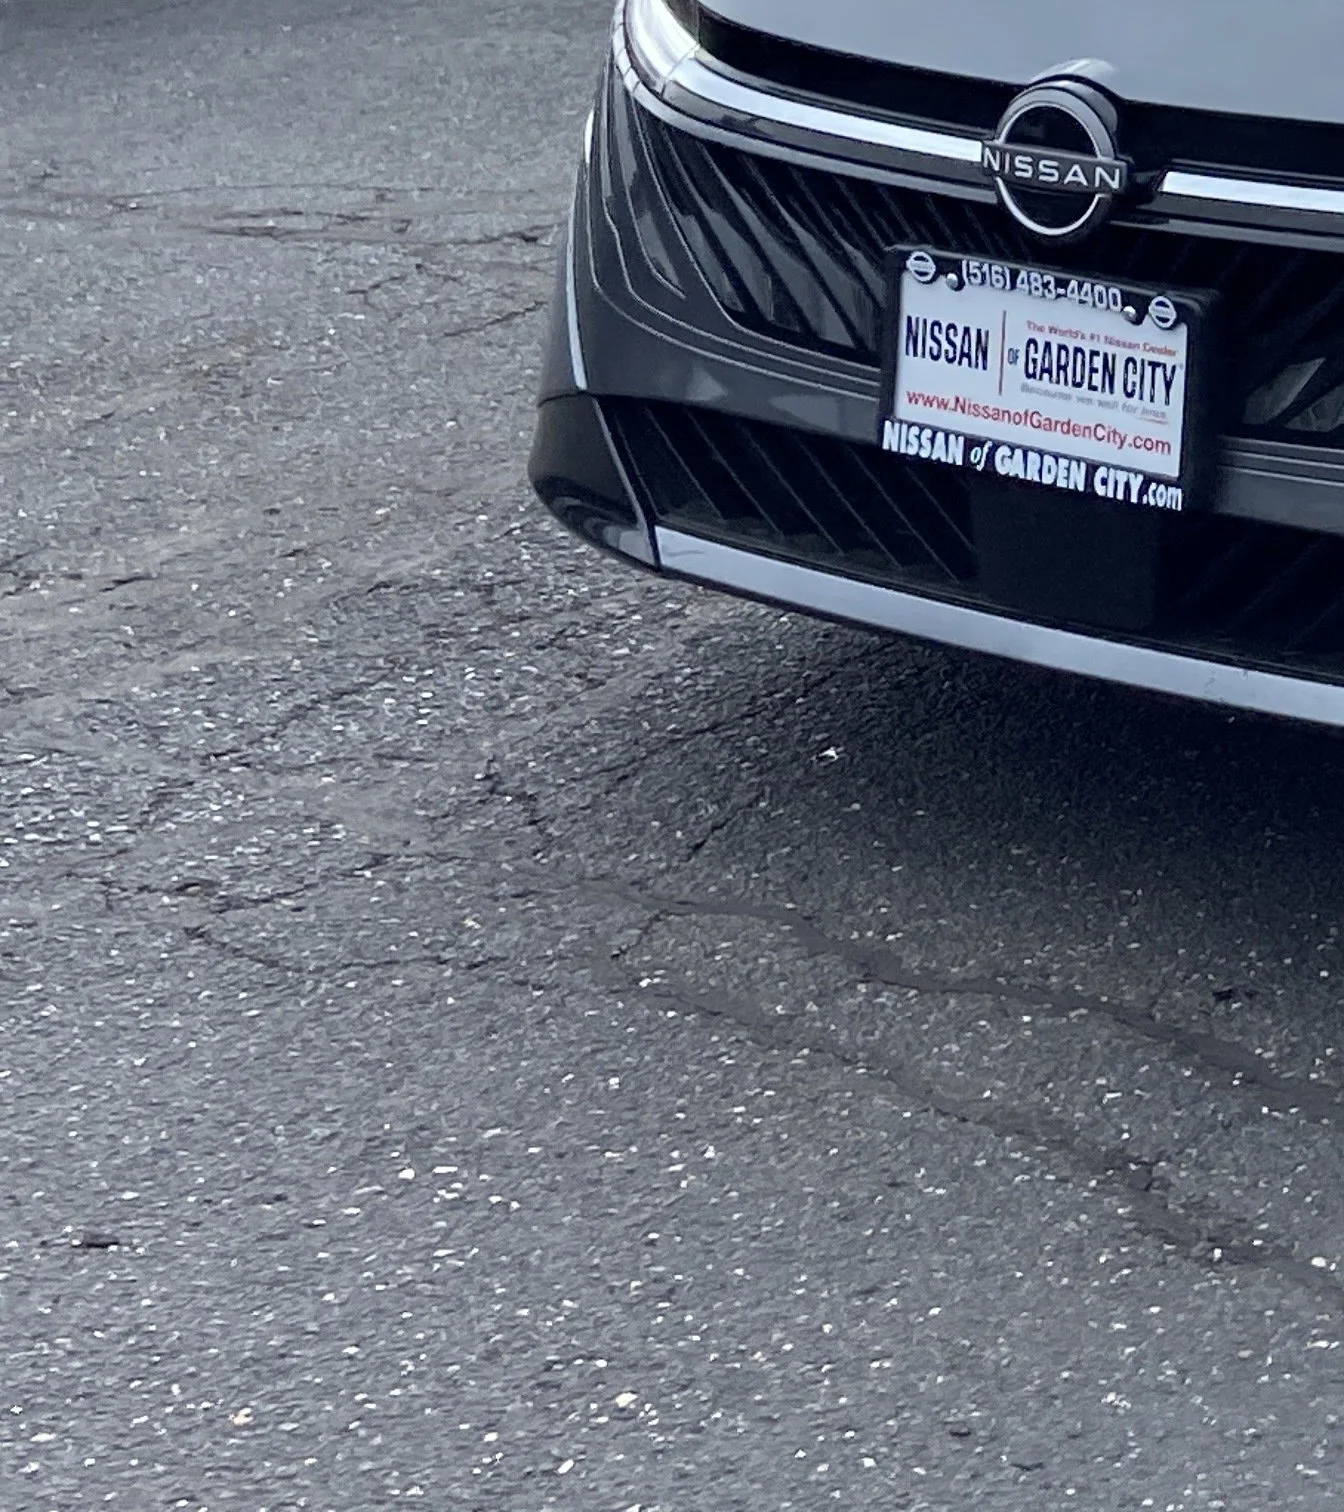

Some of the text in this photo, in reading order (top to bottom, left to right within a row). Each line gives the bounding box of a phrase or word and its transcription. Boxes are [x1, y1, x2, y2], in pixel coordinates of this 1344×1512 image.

[984, 147, 1121, 190] NISSAN
[962, 259, 1123, 313] (516) 483-4400
[905, 315, 1177, 406] NISSAN OF GARDEN CITY
[1026, 319, 1046, 333] The
[1104, 335, 1140, 350] Nissan
[905, 390, 1172, 455] www.NissanofGardenCity.com
[881, 419, 1182, 512] NISSAN of GARDEN CITY.com
